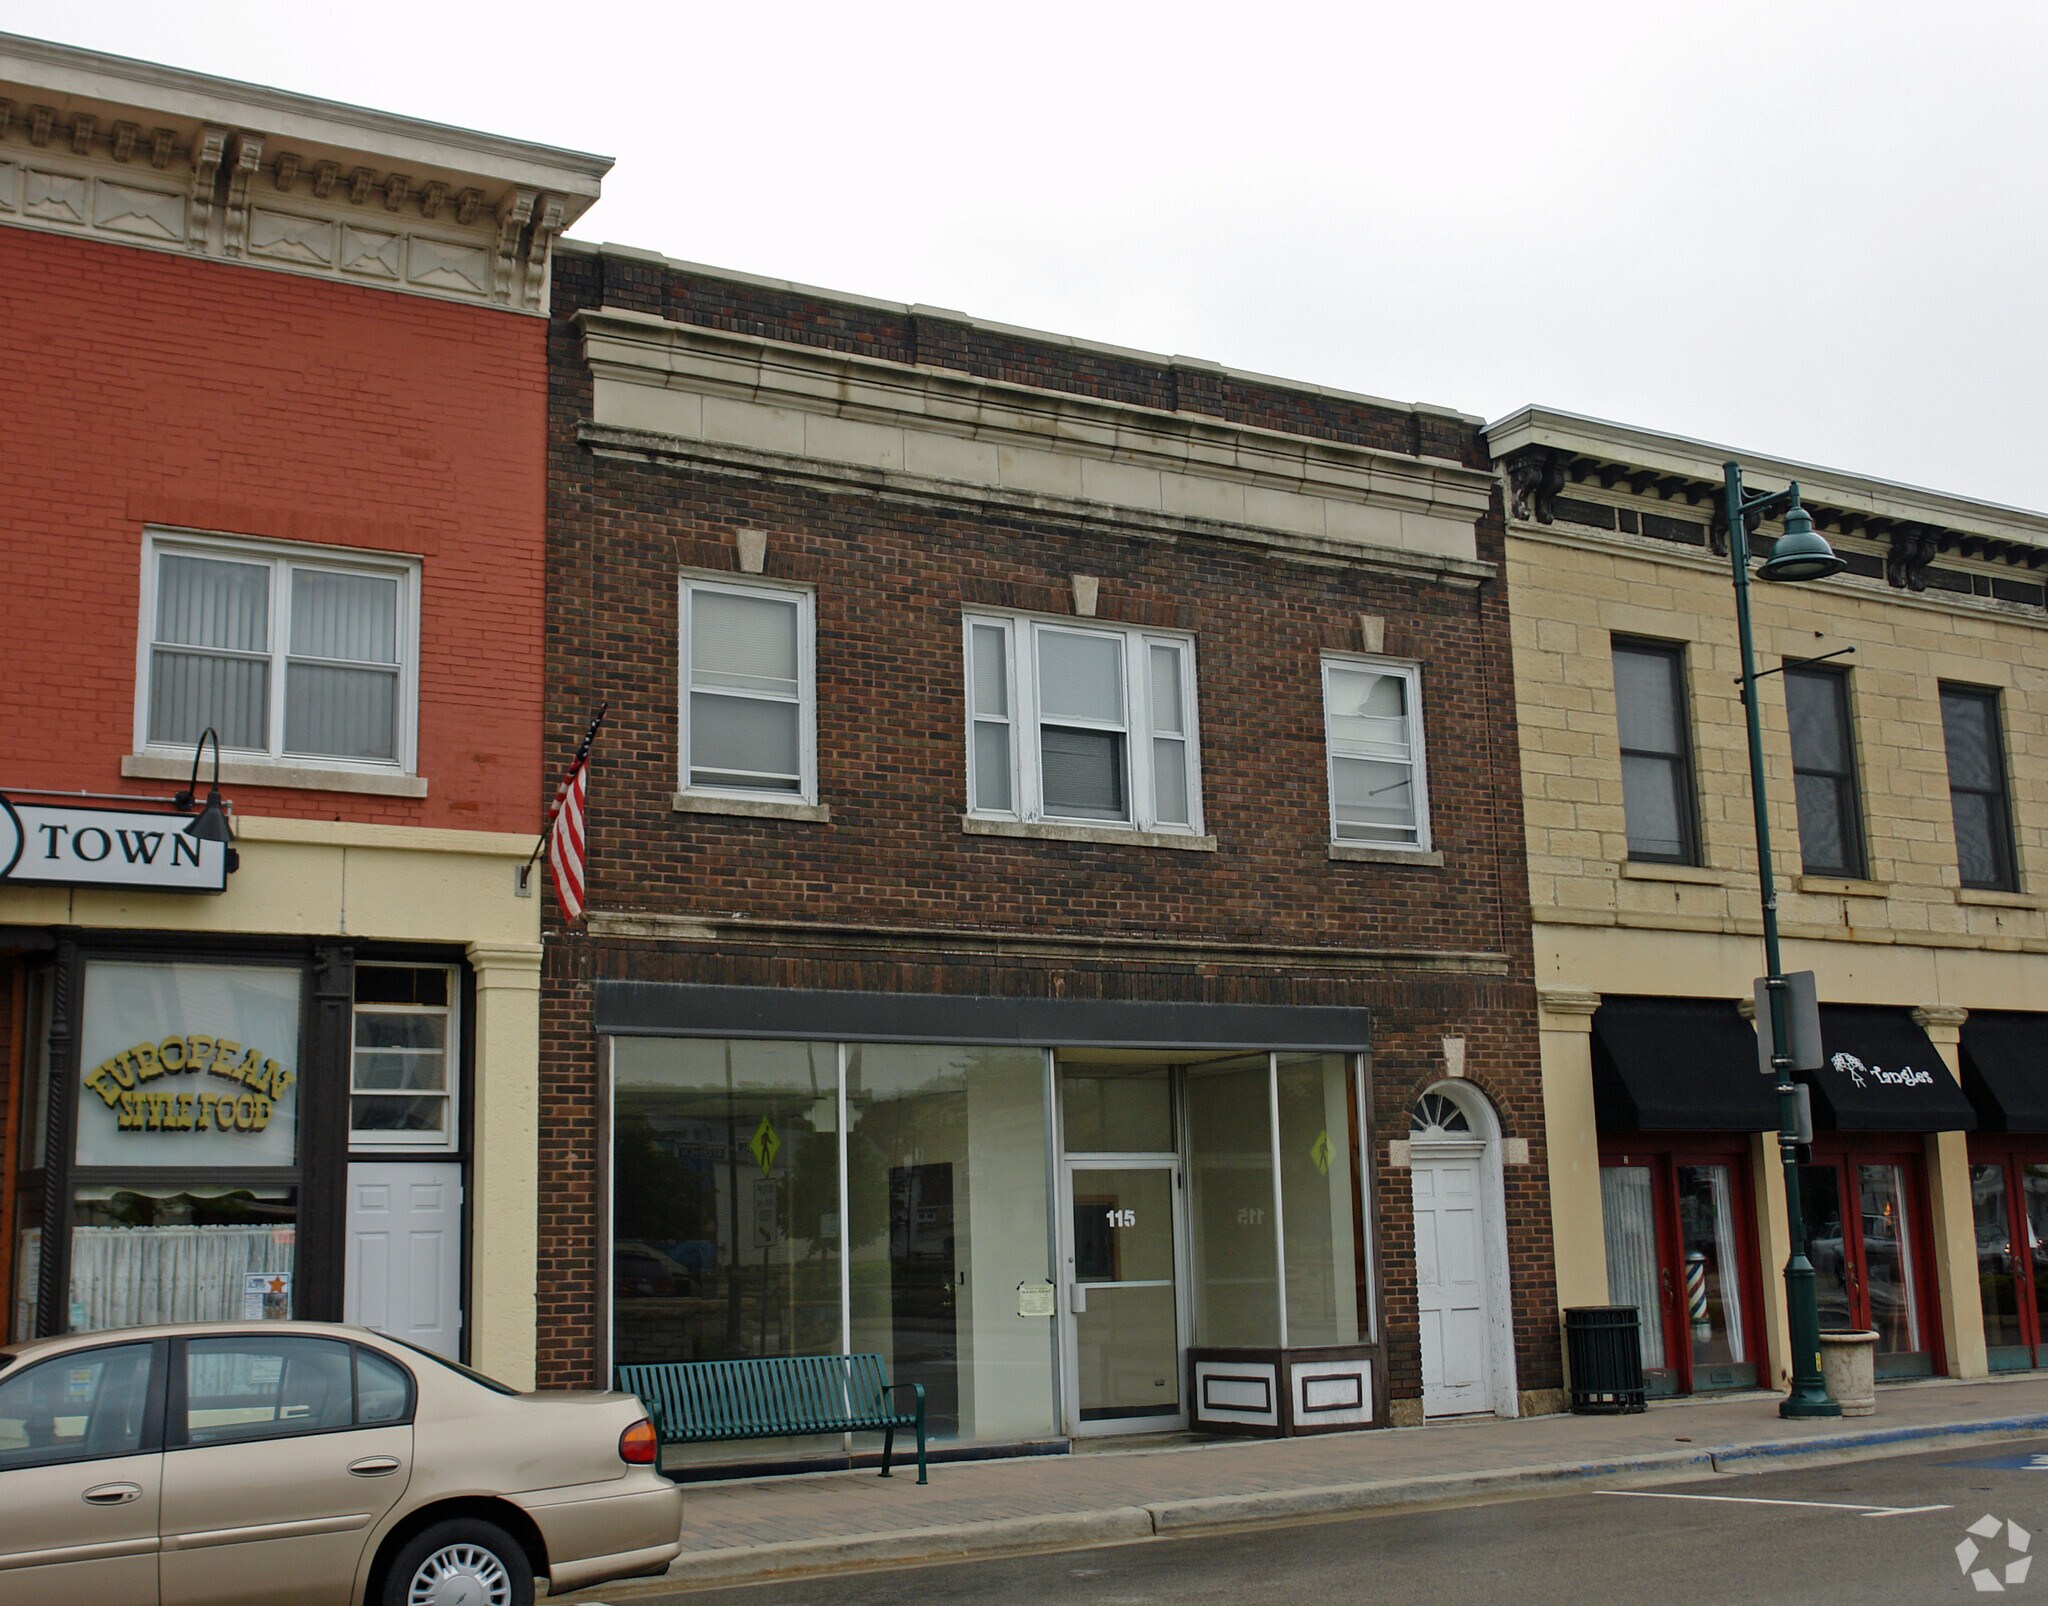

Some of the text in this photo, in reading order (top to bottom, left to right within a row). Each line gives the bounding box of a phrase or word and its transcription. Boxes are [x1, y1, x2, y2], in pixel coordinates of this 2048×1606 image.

[38, 823, 200, 867] TOWN
[84, 1034, 296, 1109] EUROPEAN
[1869, 1065, 1934, 1087] Tangles
[117, 1092, 273, 1133] STYLE FOOD
[1106, 1209, 1136, 1228] 115
